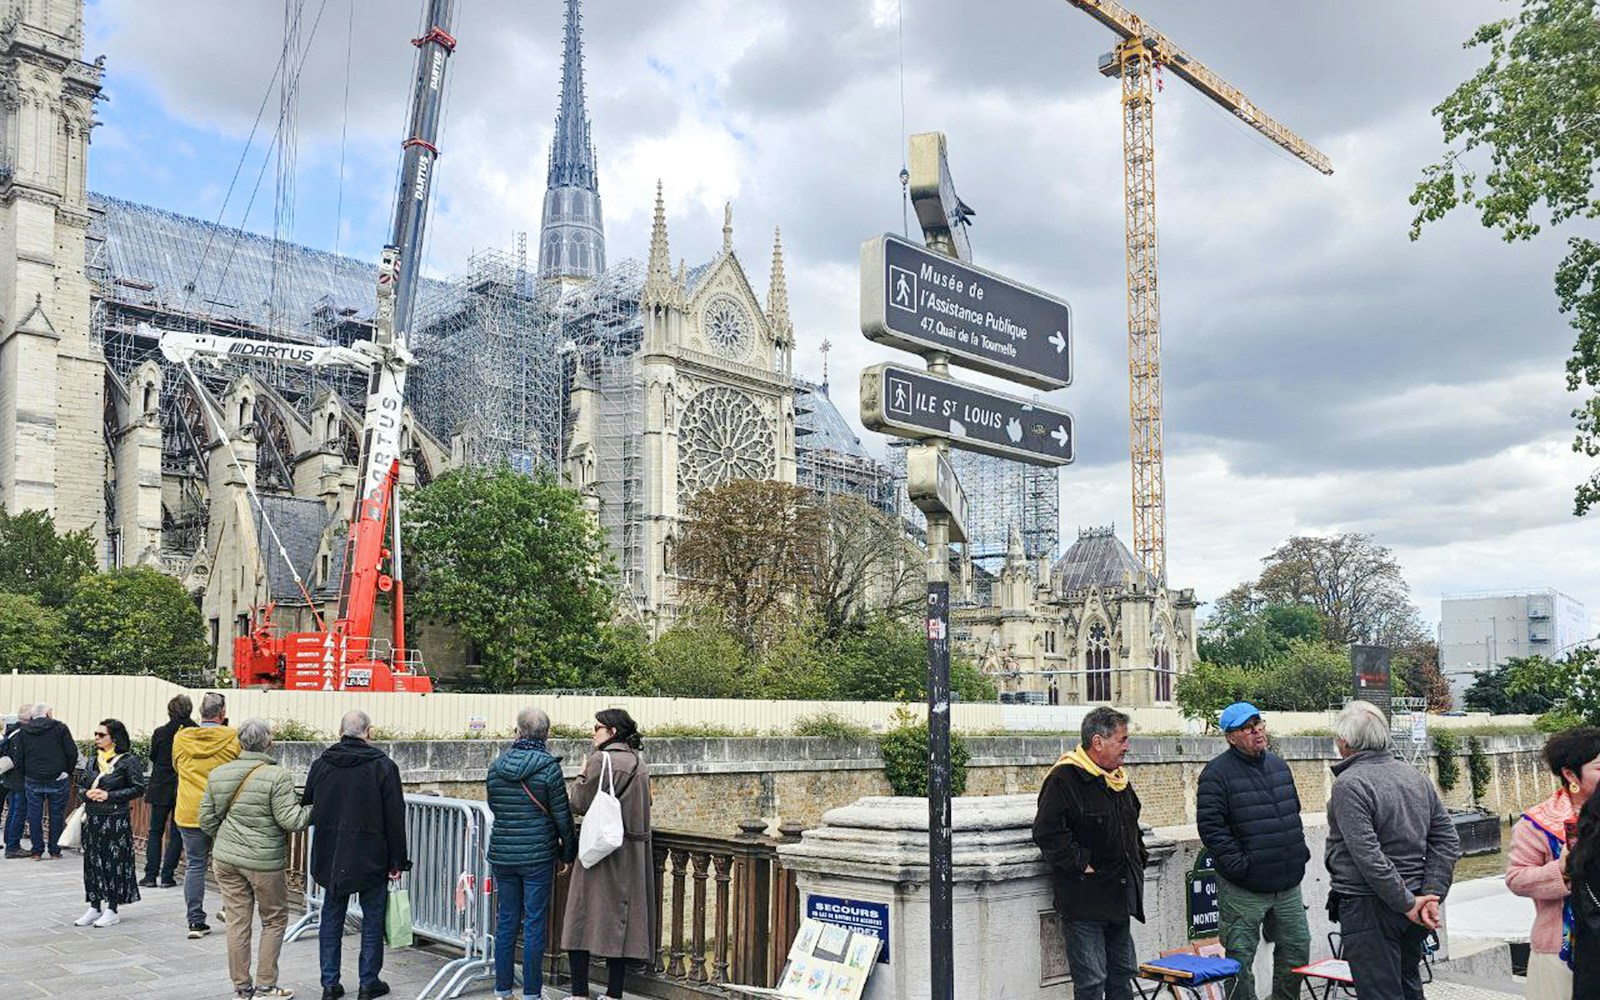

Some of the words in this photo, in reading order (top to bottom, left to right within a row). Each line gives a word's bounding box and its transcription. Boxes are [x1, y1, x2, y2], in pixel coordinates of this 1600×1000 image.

[431, 51, 442, 90] DARTUS
[414, 155, 429, 200] DARTUS
[920, 263, 963, 293] Musée
[969, 282, 984, 300] de
[920, 290, 983, 325] l'Assistance
[985, 312, 1028, 340] Publique
[936, 321, 957, 339] Quai
[958, 329, 969, 343] de
[970, 332, 979, 346] la
[981, 335, 1017, 357] Tournelle
[915, 392, 937, 413] ILE
[964, 404, 1002, 429] LOUIS
[815, 902, 880, 918] SECOURS
